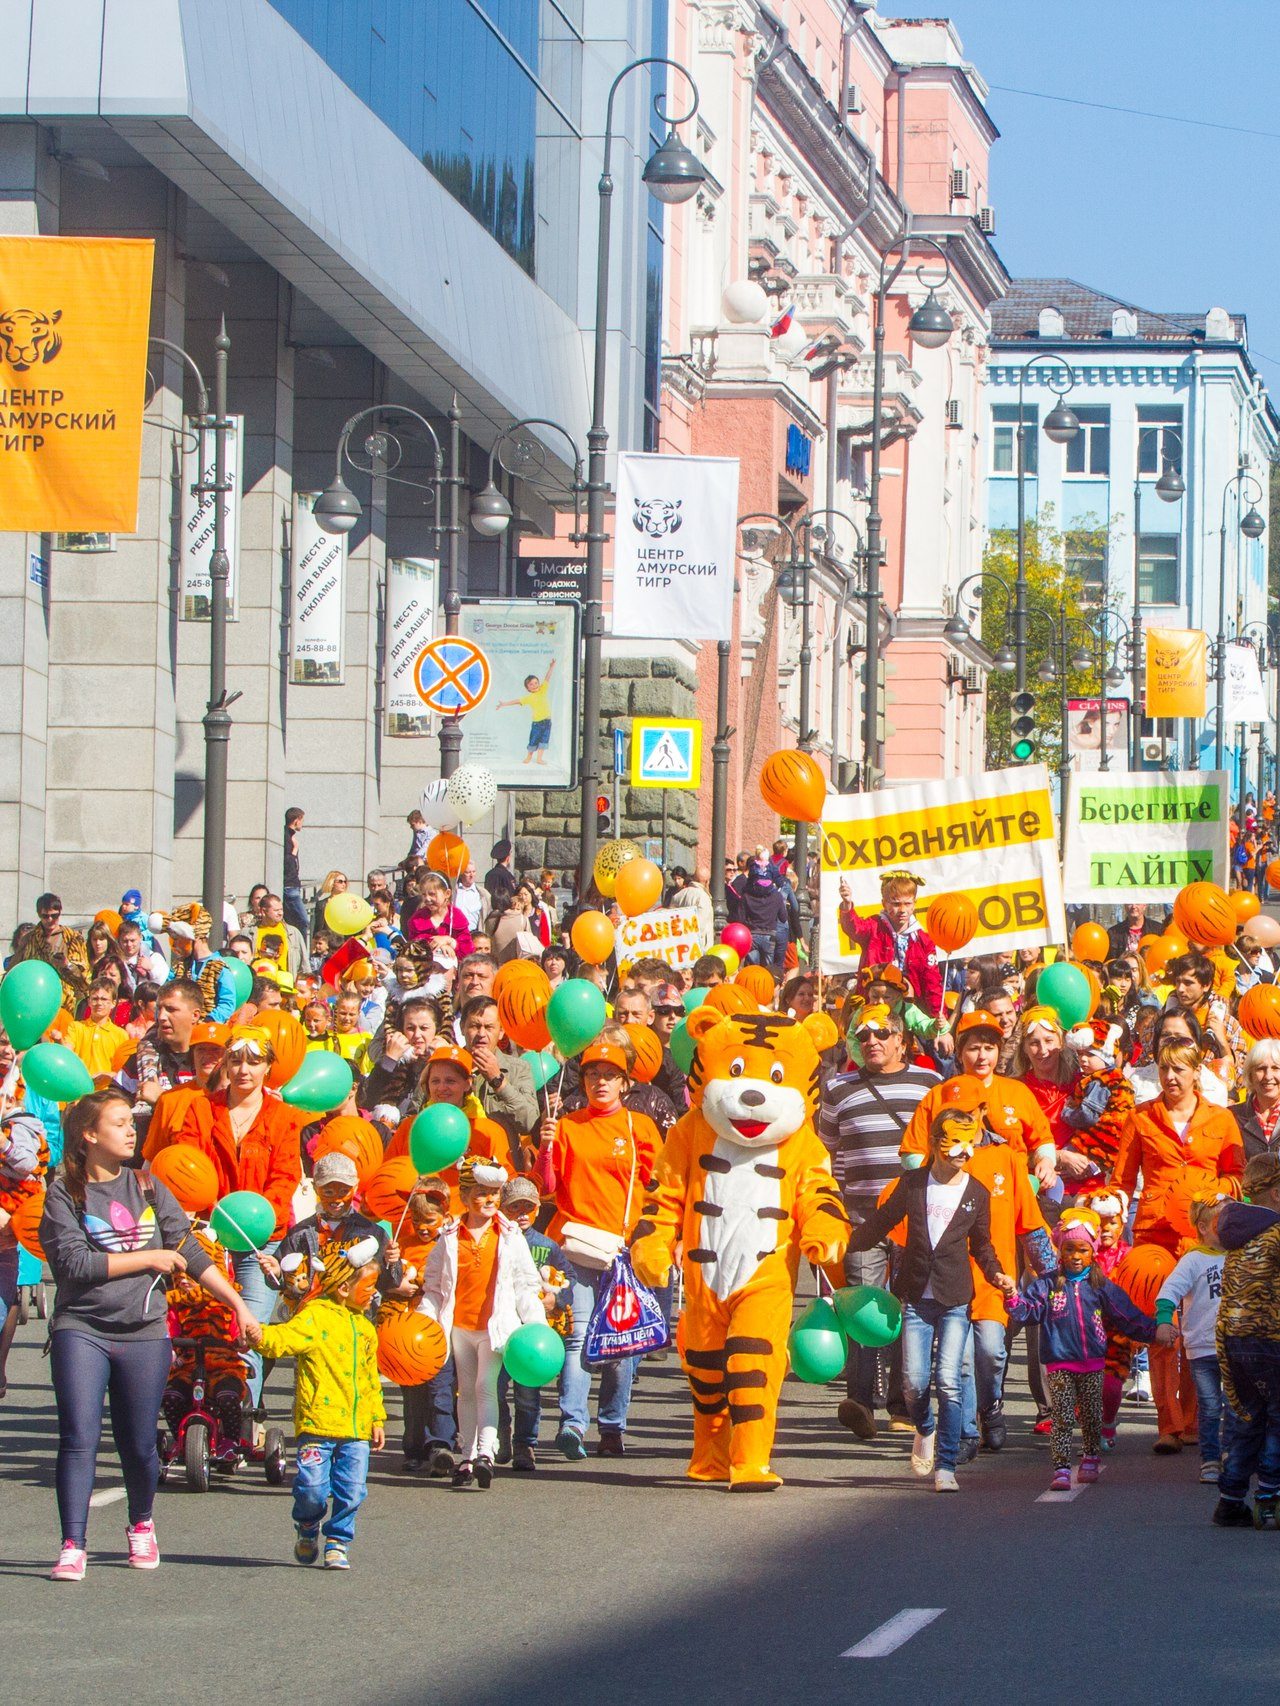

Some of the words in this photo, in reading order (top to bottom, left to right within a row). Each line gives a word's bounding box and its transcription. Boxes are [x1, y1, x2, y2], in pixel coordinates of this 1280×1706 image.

[187, 509, 206, 533] ДЛЯ
[190, 506, 231, 555] РЕКЛАЫ
[299, 536, 327, 570] МЕСТО
[637, 549, 684, 560] ЦЕНТР
[297, 579, 314, 601] ДЛЯ
[312, 545, 341, 580] ВАШЕЙ
[541, 562, 588, 575] iMarket
[636, 562, 717, 576] АМУРСКИЙ
[636, 576, 672, 588] ТИГР
[531, 591, 581, 599] сервисное
[533, 579, 579, 588] Продажа,
[299, 576, 338, 623] РЕКЛАМЫ
[393, 599, 419, 630] МЕСТО
[390, 640, 407, 660] ДЛЯ
[405, 607, 433, 639] ВАШЕЙ
[296, 644, 337, 653] 245-88-88
[393, 636, 429, 680] РЕКЛАМЫ
[1080, 796, 1212, 824] Берегите
[823, 808, 1041, 868] Охраняйте
[639, 916, 700, 943] ДНЁМ
